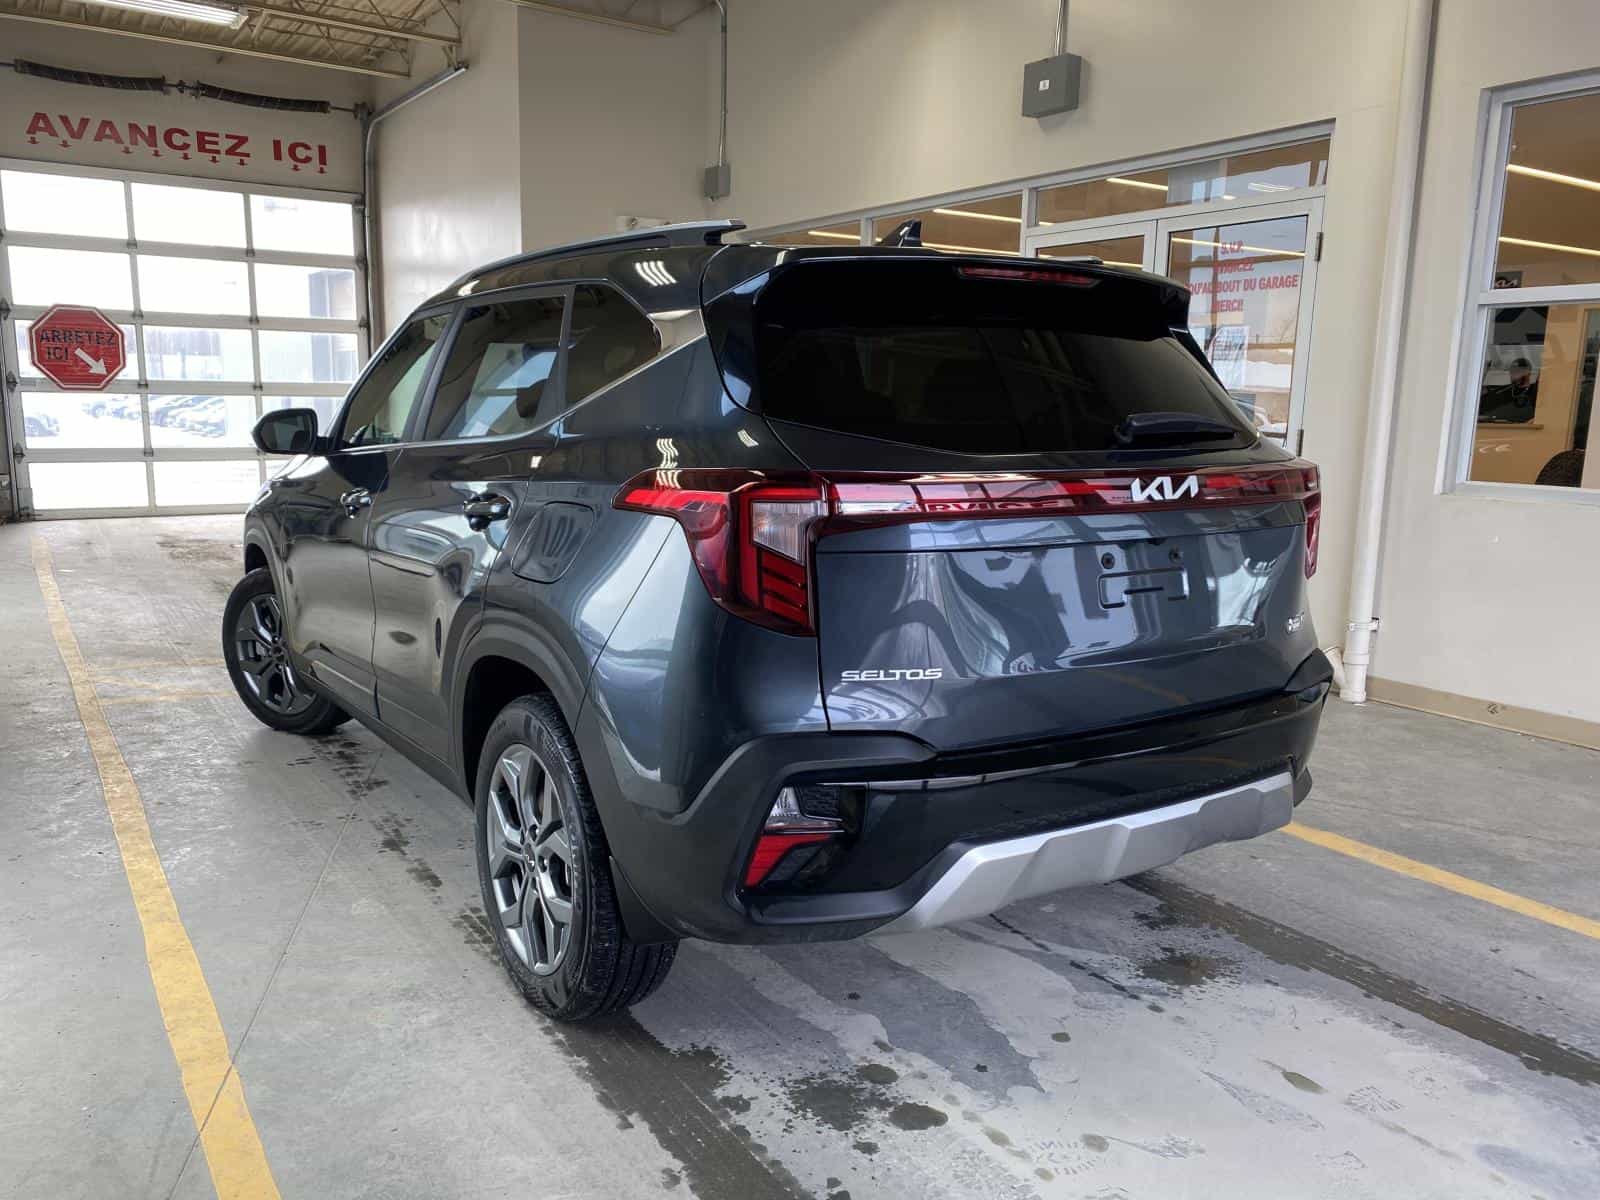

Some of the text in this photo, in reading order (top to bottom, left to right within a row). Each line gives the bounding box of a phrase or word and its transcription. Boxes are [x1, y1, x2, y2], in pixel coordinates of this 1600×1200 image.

[26, 111, 250, 158] AVANCEZ
[1243, 278, 1256, 290] DU
[1258, 274, 1299, 289] GARAGE
[47, 346, 69, 360] ICI
[1131, 475, 1199, 502] KIA
[841, 667, 943, 681] SELTOS
